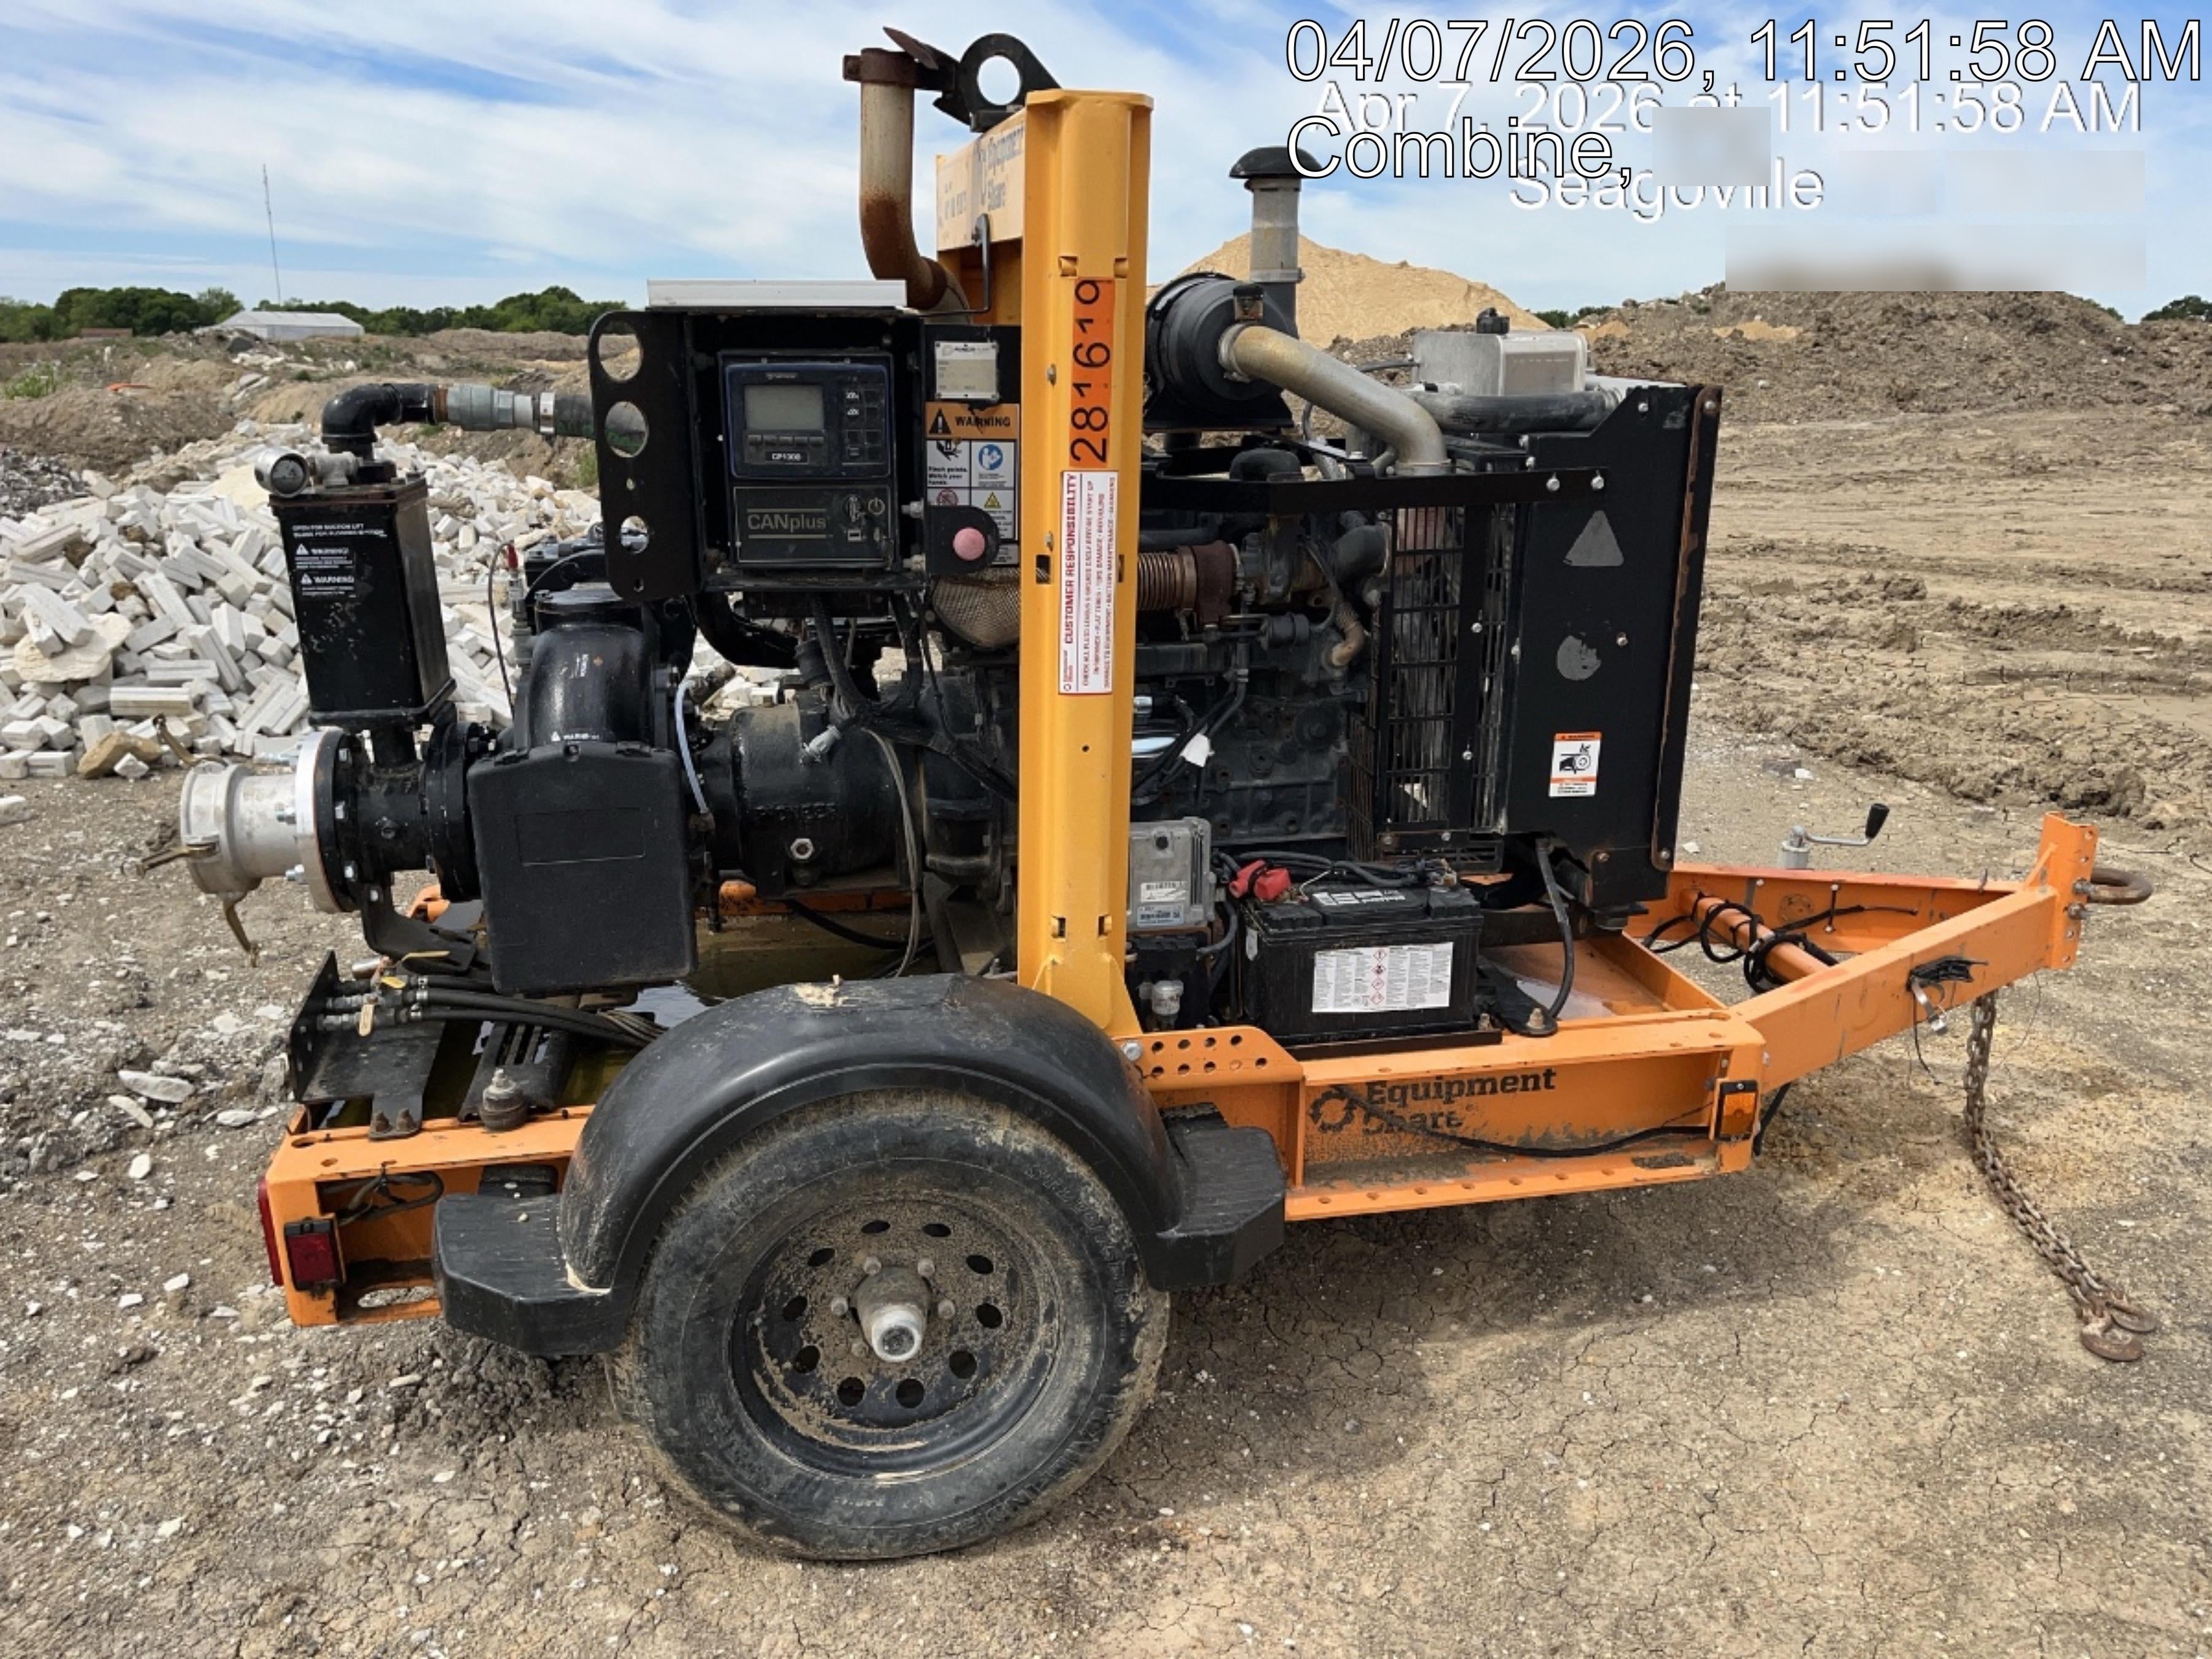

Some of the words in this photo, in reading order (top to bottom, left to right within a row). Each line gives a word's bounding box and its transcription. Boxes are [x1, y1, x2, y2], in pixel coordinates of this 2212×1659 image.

[955, 416, 1011, 427] WARNING
[748, 514, 826, 533] CANplus
[1065, 473, 1077, 577] RESPONSIBILITY
[1065, 580, 1074, 644] CUSTOMER
[1365, 1068, 1556, 1108] Equipment
